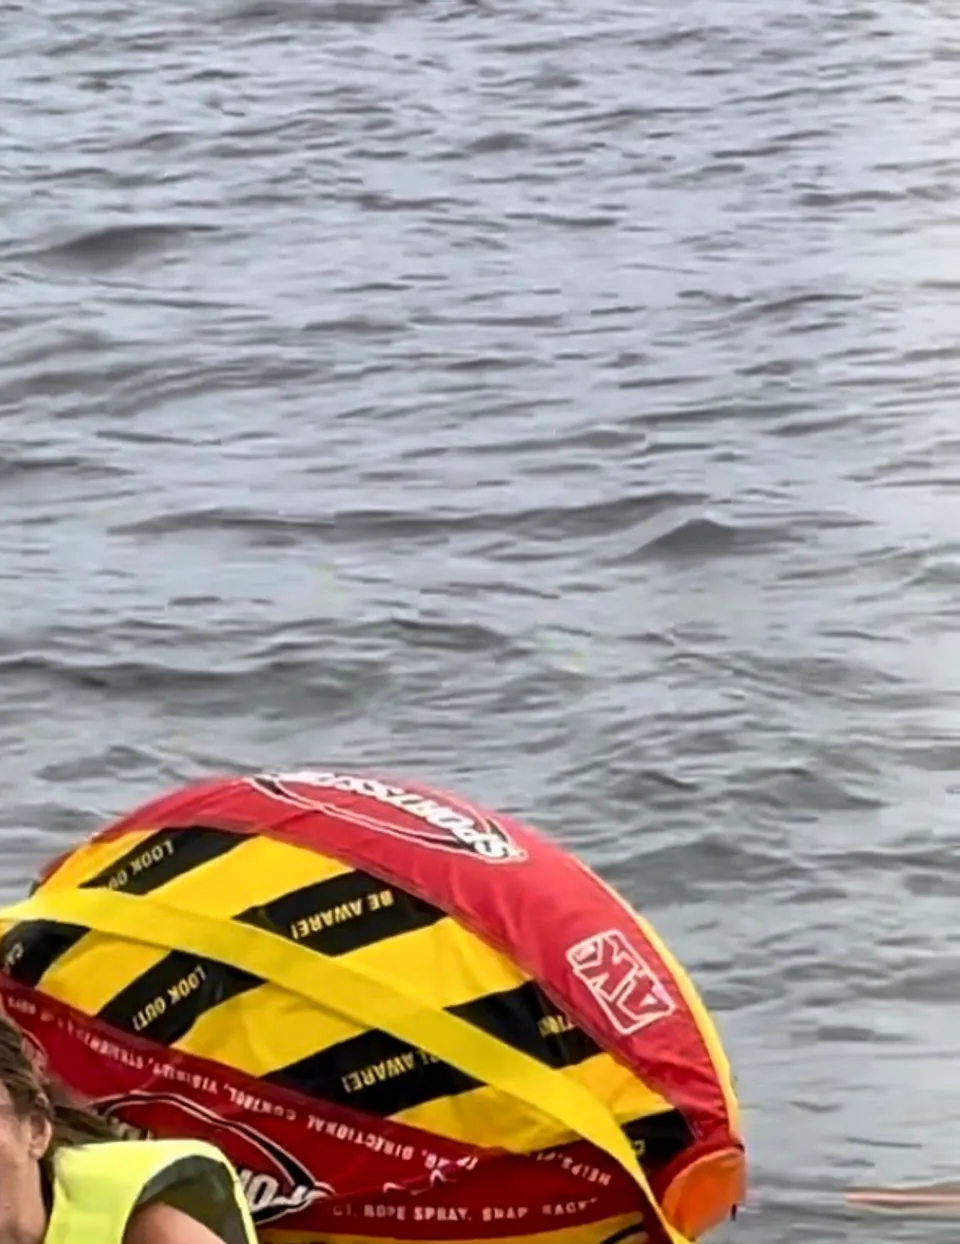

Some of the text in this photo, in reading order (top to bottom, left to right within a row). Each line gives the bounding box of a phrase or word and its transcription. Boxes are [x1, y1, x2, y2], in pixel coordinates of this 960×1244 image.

[130, 839, 174, 872] LOOK
[289, 889, 395, 940] BE AWARE!
[131, 965, 206, 1032] LOOK OUT!
[340, 1051, 414, 1095] AWARE!
